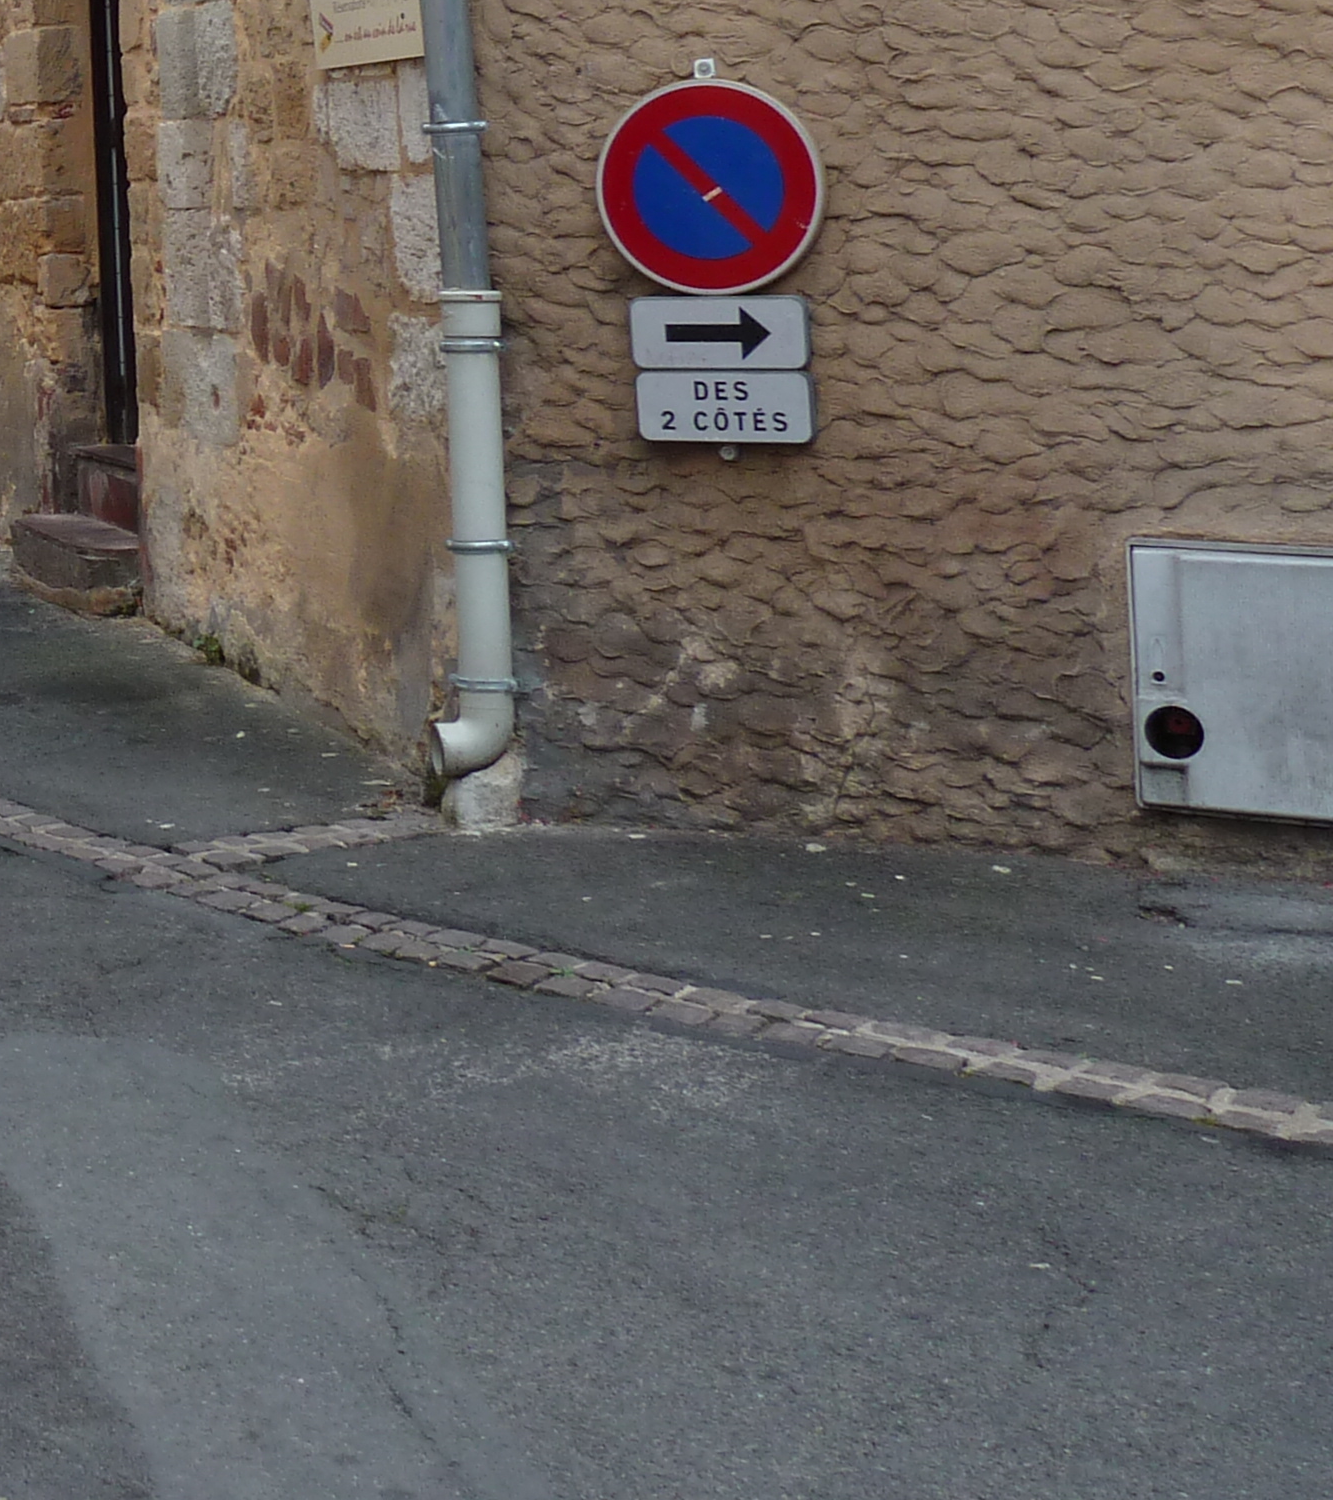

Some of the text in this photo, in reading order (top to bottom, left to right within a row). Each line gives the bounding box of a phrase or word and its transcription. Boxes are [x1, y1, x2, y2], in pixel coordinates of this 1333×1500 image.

[693, 380, 749, 401] DES
[660, 407, 789, 433] 2 CÔTÉS
